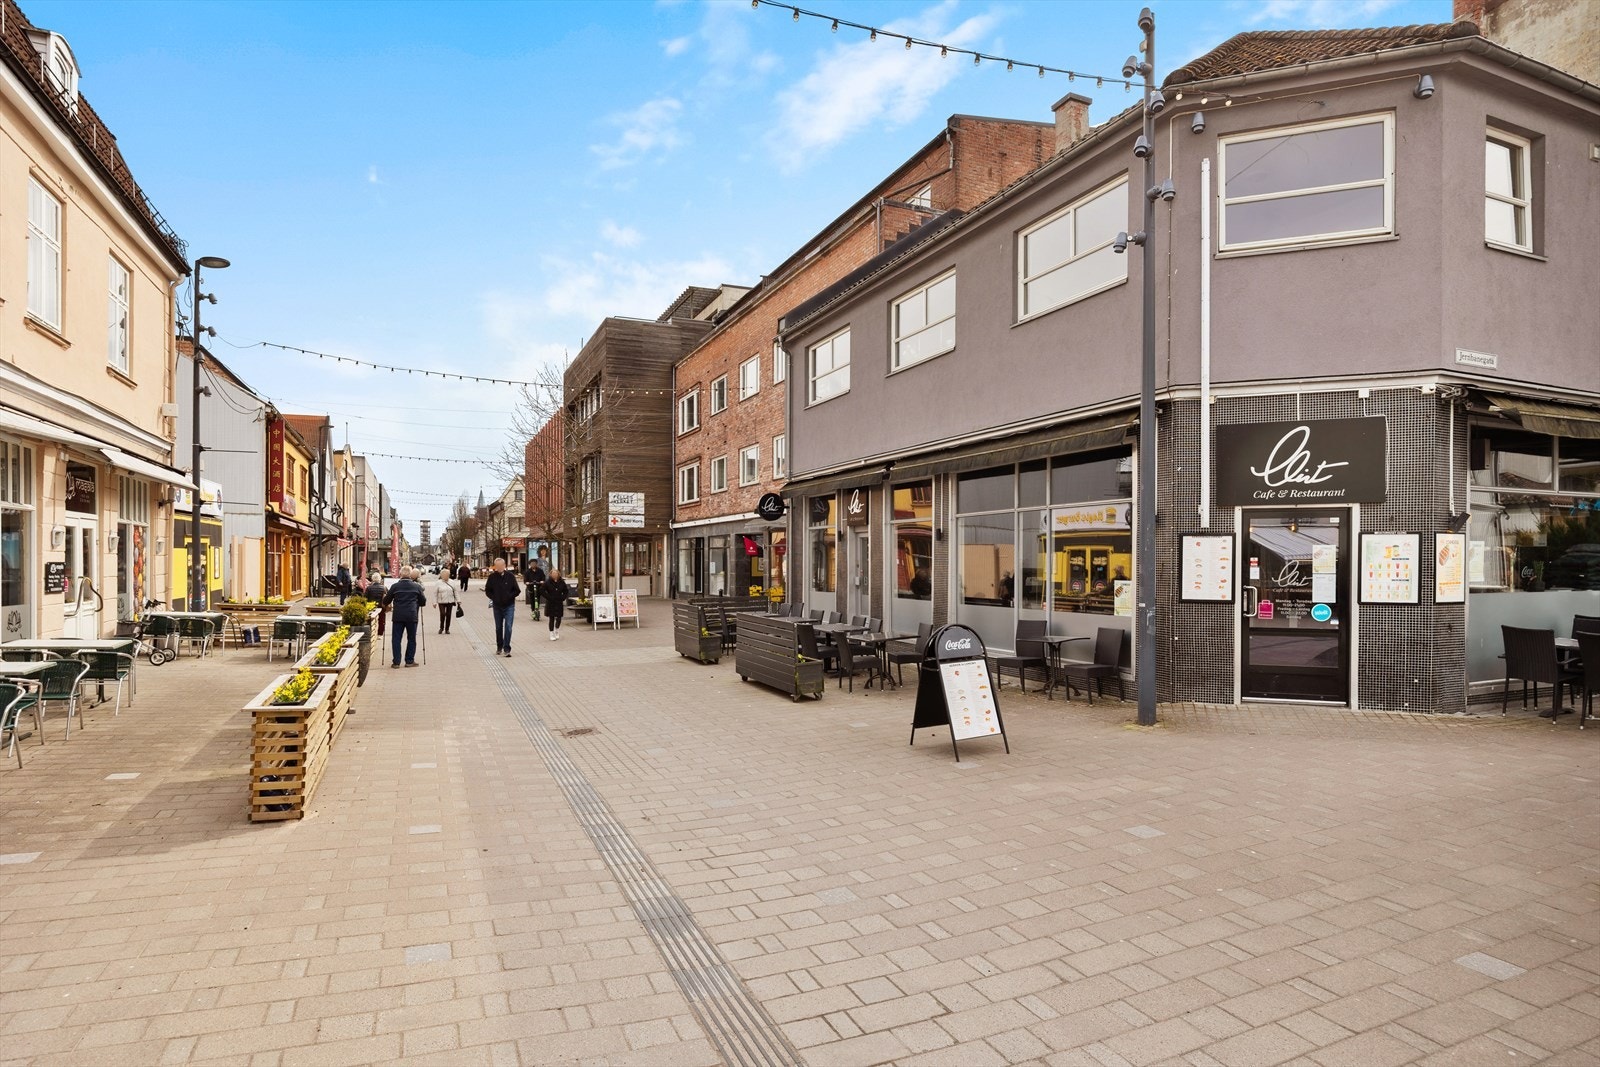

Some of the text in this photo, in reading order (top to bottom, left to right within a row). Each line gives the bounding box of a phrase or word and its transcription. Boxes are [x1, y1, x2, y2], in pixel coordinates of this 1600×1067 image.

[1458, 351, 1495, 365] Jernbanegata
[1253, 488, 1346, 500] Cafe & Restaurant
